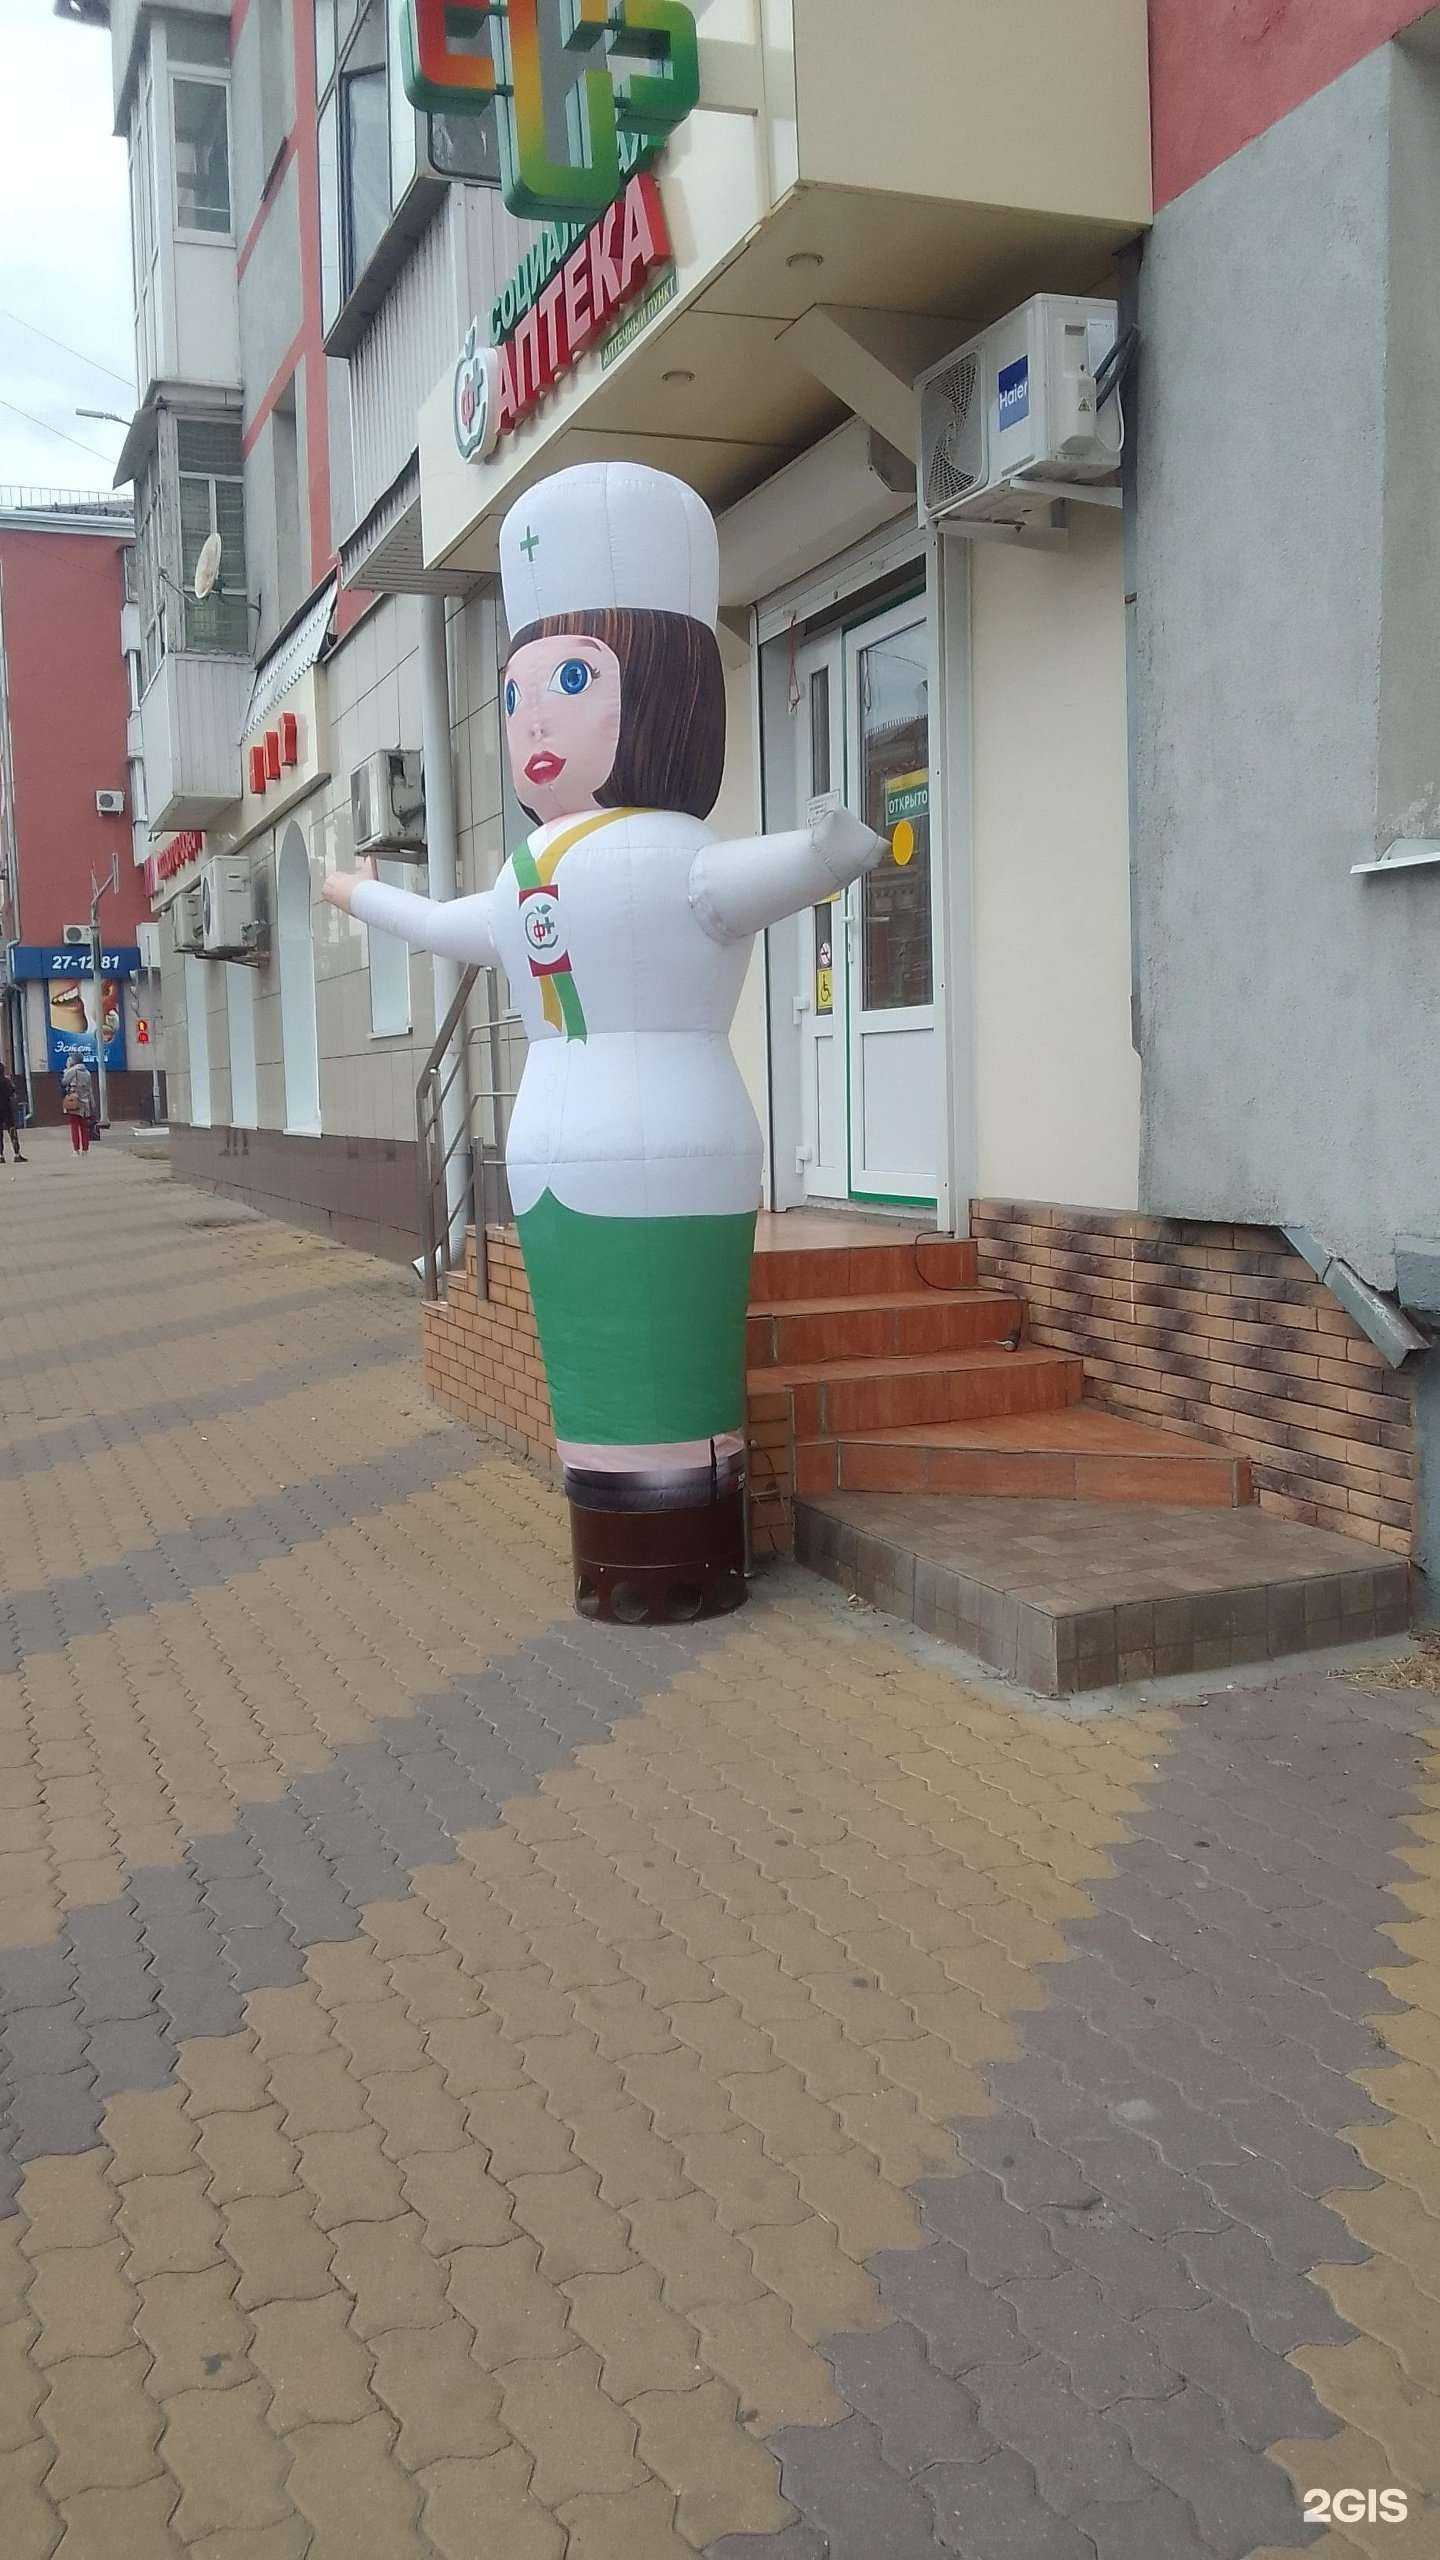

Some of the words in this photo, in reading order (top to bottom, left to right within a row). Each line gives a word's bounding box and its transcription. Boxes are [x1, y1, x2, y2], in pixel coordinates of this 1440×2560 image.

[497, 172, 657, 428] АПТЕКА
[1000, 381, 1028, 408] Haier
[888, 789, 928, 814] ОТКРЫТО
